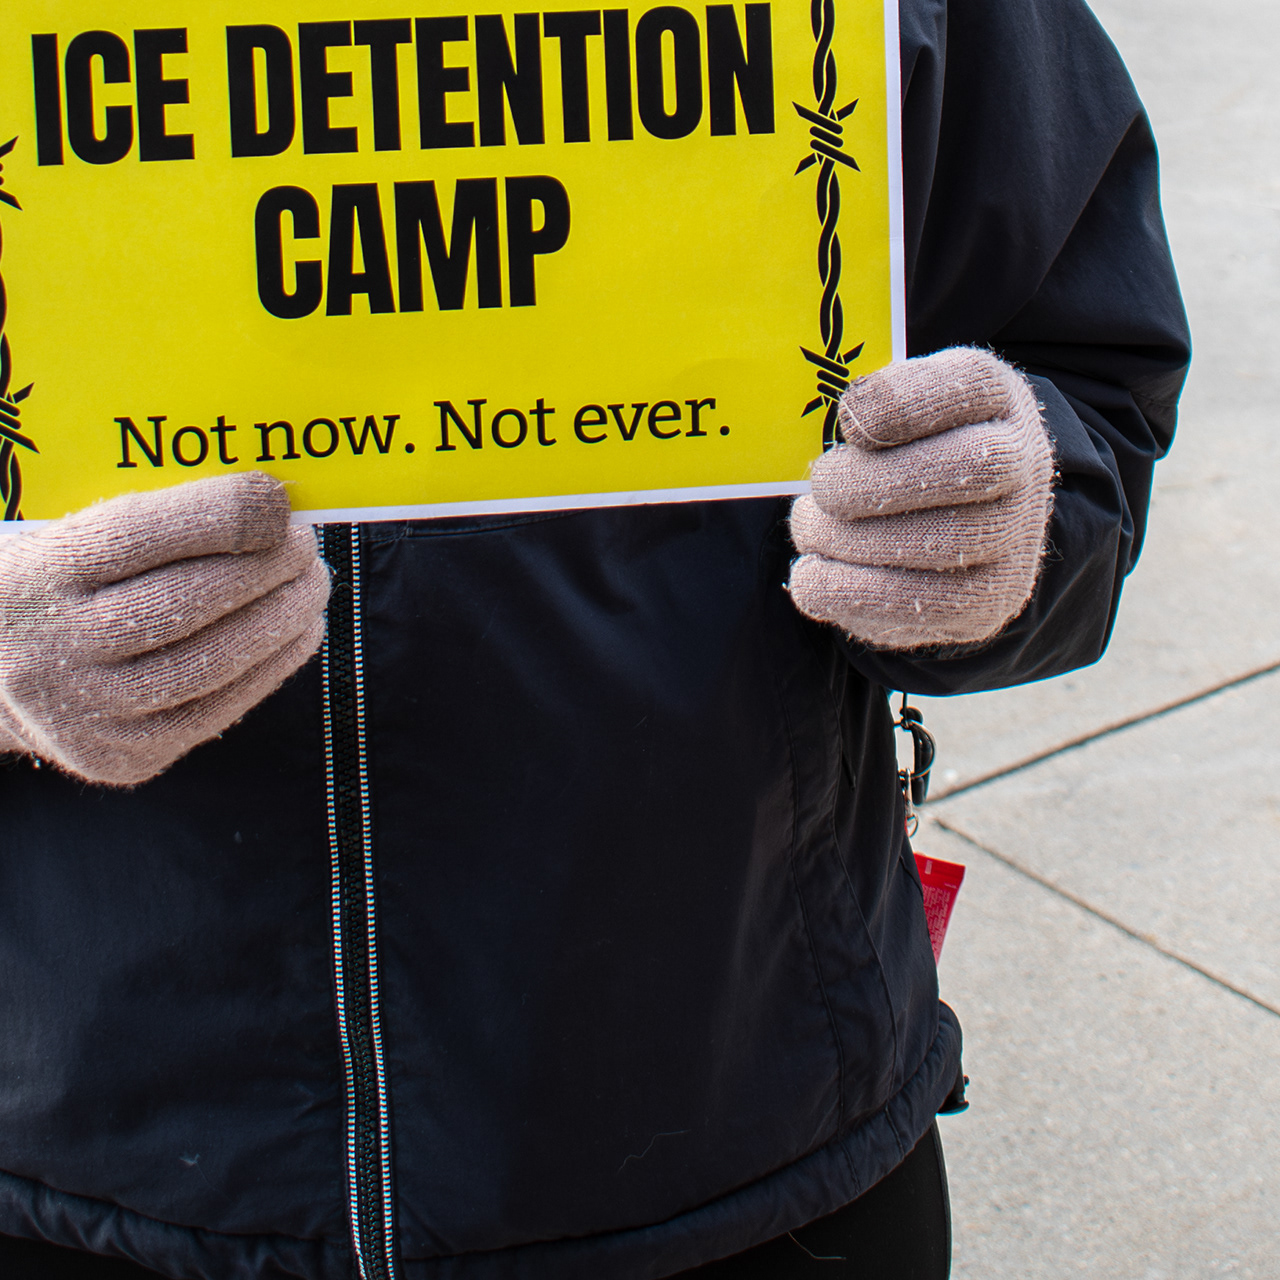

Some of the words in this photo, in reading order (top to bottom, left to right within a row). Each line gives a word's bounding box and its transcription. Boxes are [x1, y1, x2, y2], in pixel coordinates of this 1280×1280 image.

[32, 28, 196, 168] ICE
[226, 3, 777, 160] DETENTION
[255, 175, 572, 321] CAMP
[114, 415, 241, 470] Not
[254, 414, 417, 464] now.
[434, 398, 558, 454] Not
[574, 398, 731, 445] ever.
